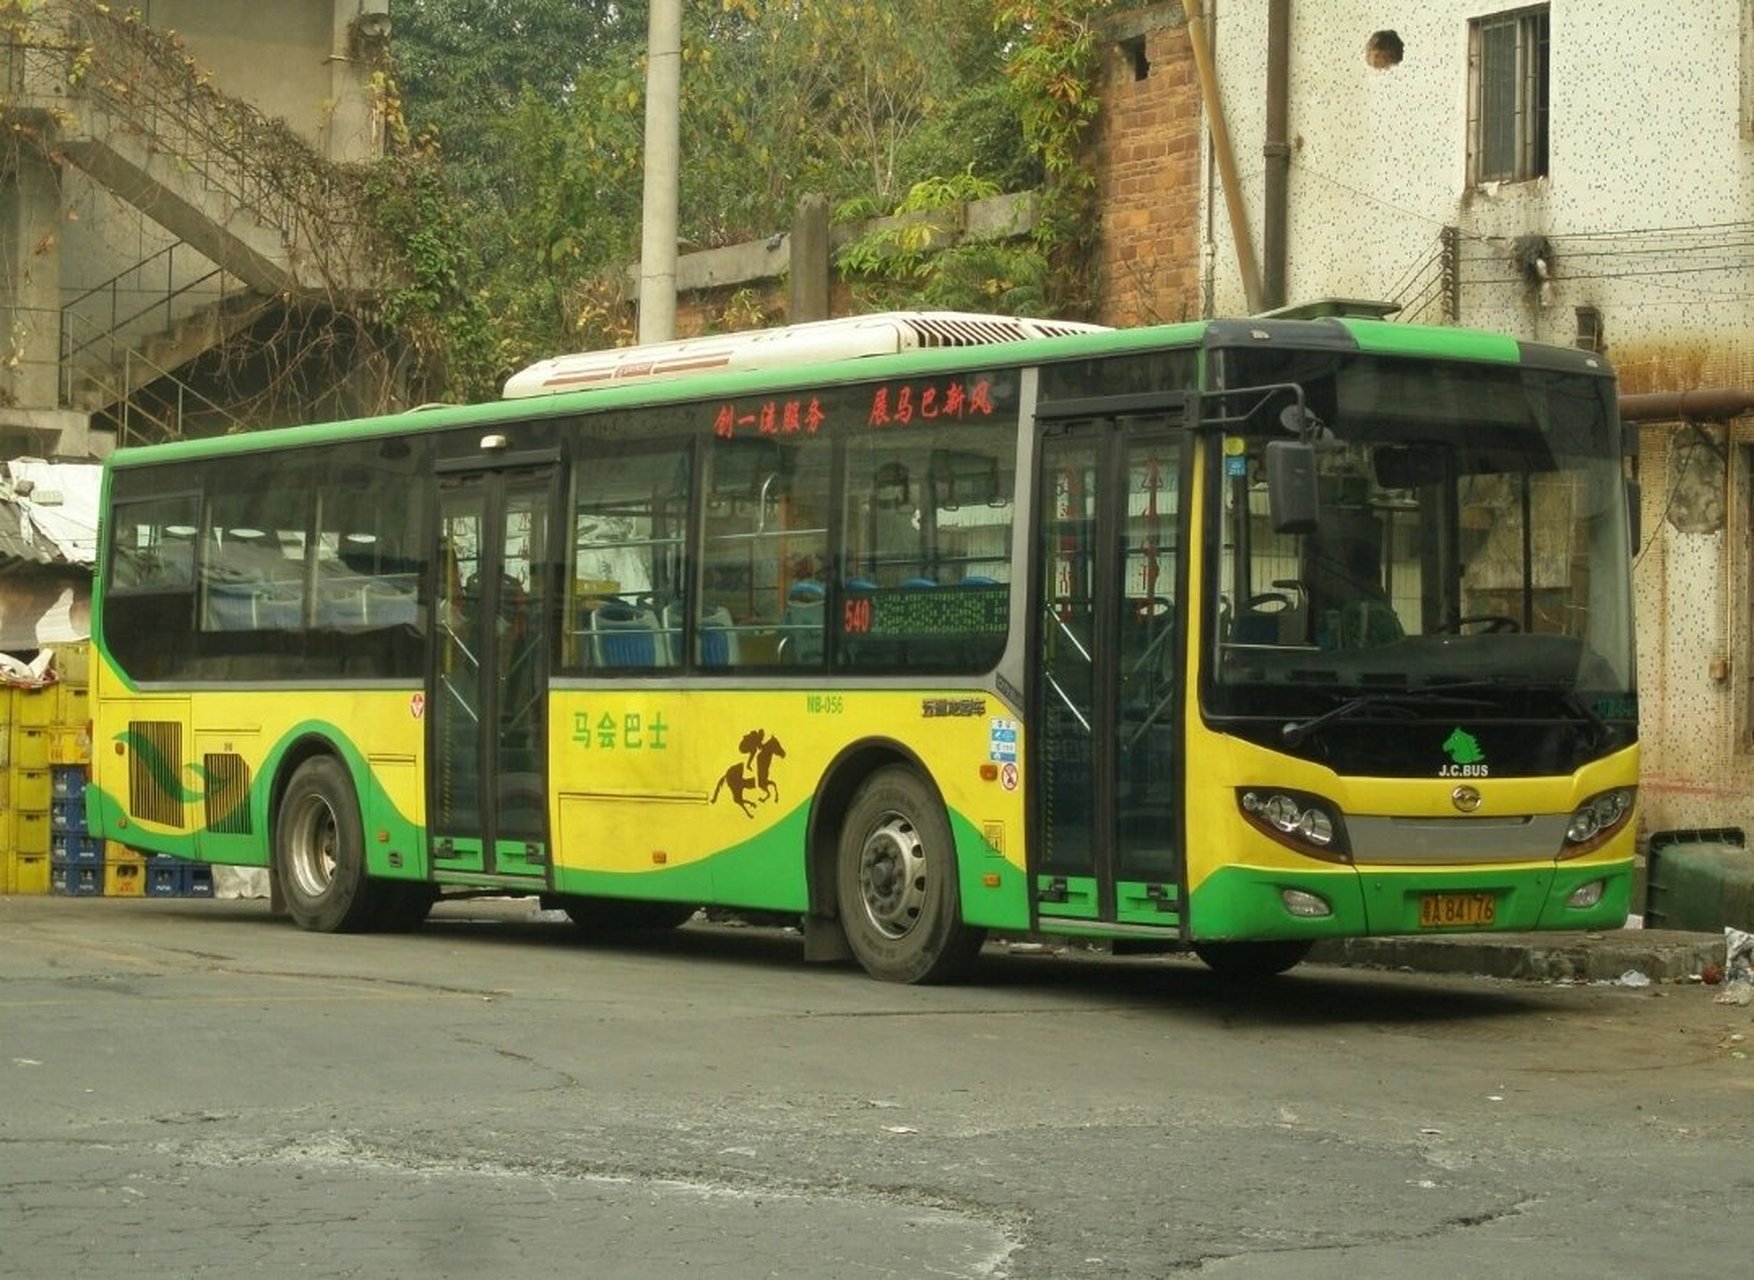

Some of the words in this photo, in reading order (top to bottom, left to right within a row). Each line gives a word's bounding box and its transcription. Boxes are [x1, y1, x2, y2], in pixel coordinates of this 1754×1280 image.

[714, 397, 825, 438] 创一流服务
[845, 598, 871, 633] 540
[807, 695, 844, 714] NB-056
[572, 711, 669, 749] 马会巴士
[1438, 764, 1489, 777] J.C.BUS
